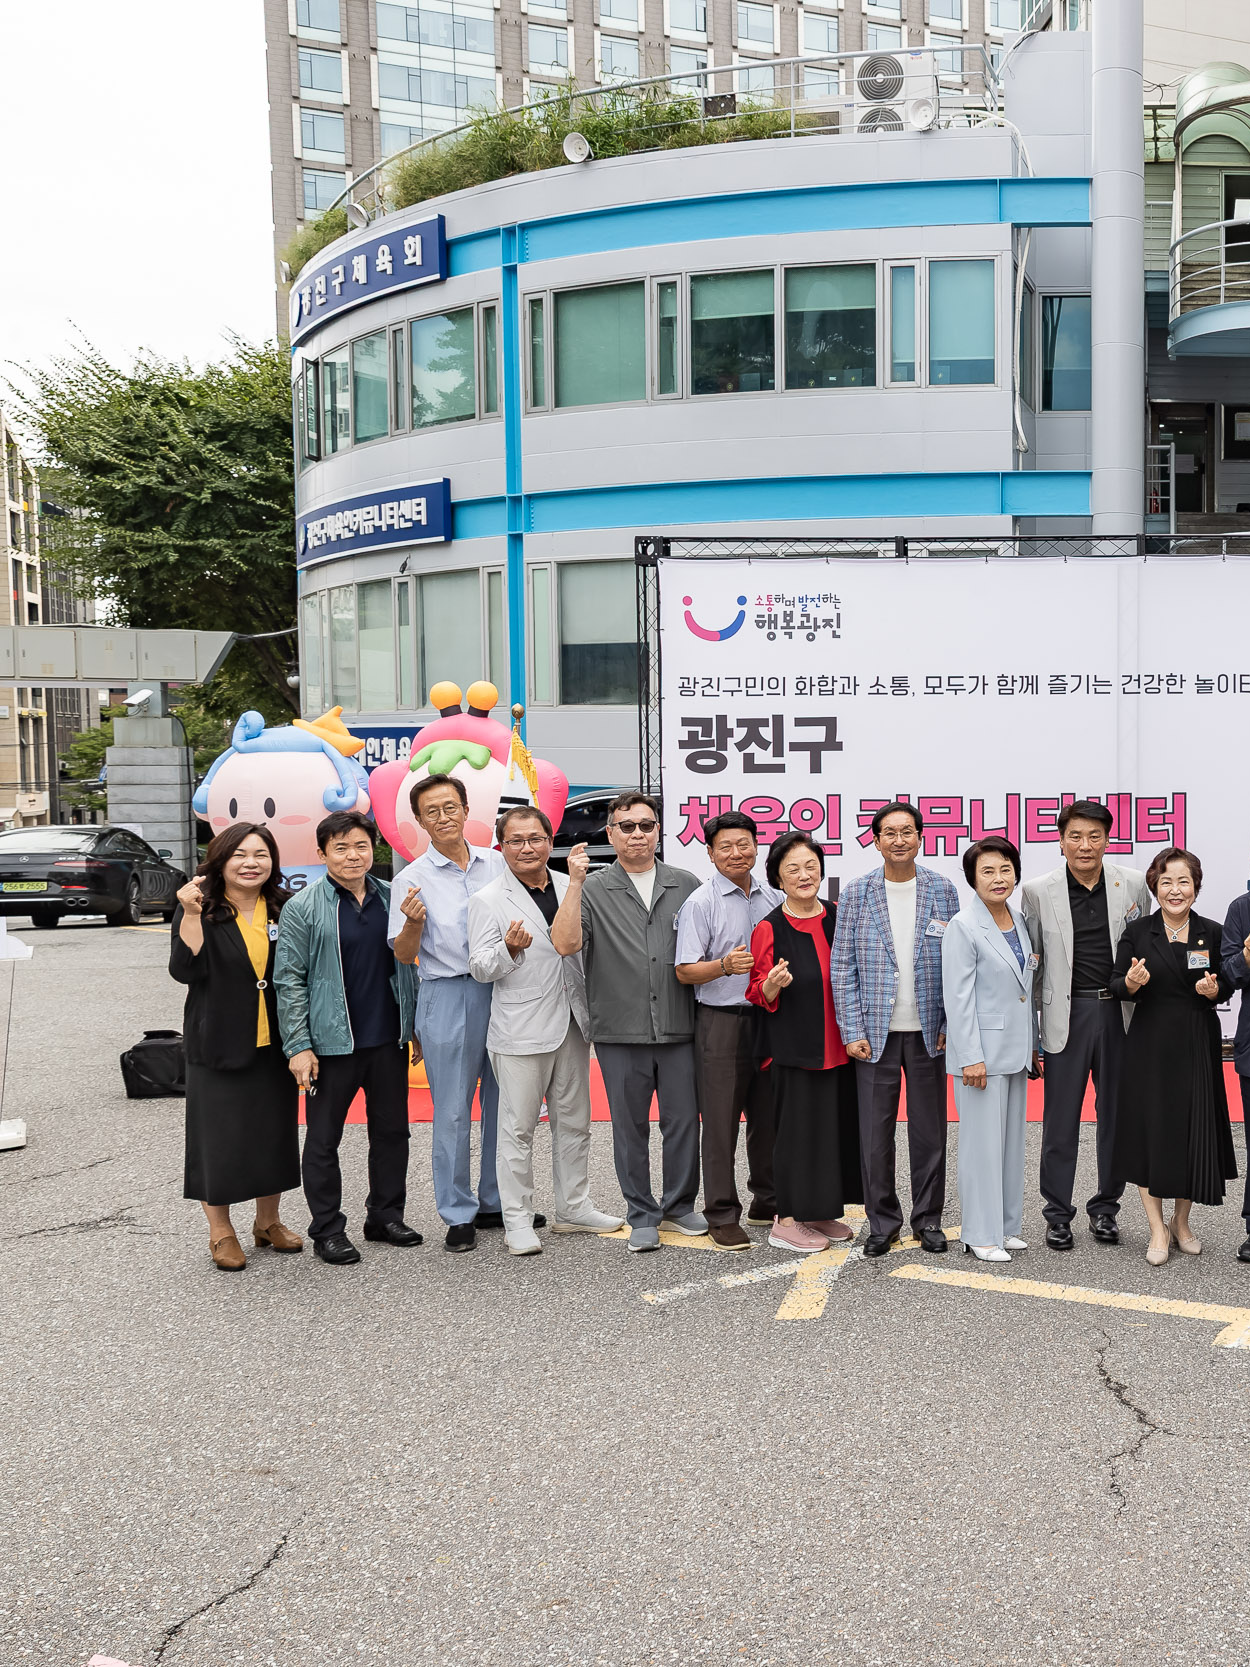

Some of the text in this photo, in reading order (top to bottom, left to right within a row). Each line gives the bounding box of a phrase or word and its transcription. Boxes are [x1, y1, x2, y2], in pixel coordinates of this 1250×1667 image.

[301, 234, 422, 316] 광진구체육회
[307, 497, 427, 549] 광진구체육인커뮤니티센터
[754, 592, 841, 613] 소통하며 발전하는
[754, 610, 841, 642] 행복광진
[678, 676, 786, 697] 광진구민의
[794, 675, 860, 696] 화합과
[867, 675, 915, 697] 소통,
[923, 674, 989, 695] 모두가
[996, 673, 1039, 695] 함께
[1047, 674, 1113, 695] 즐기는
[1121, 673, 1186, 695] 건강한
[678, 714, 844, 774] 광진구
